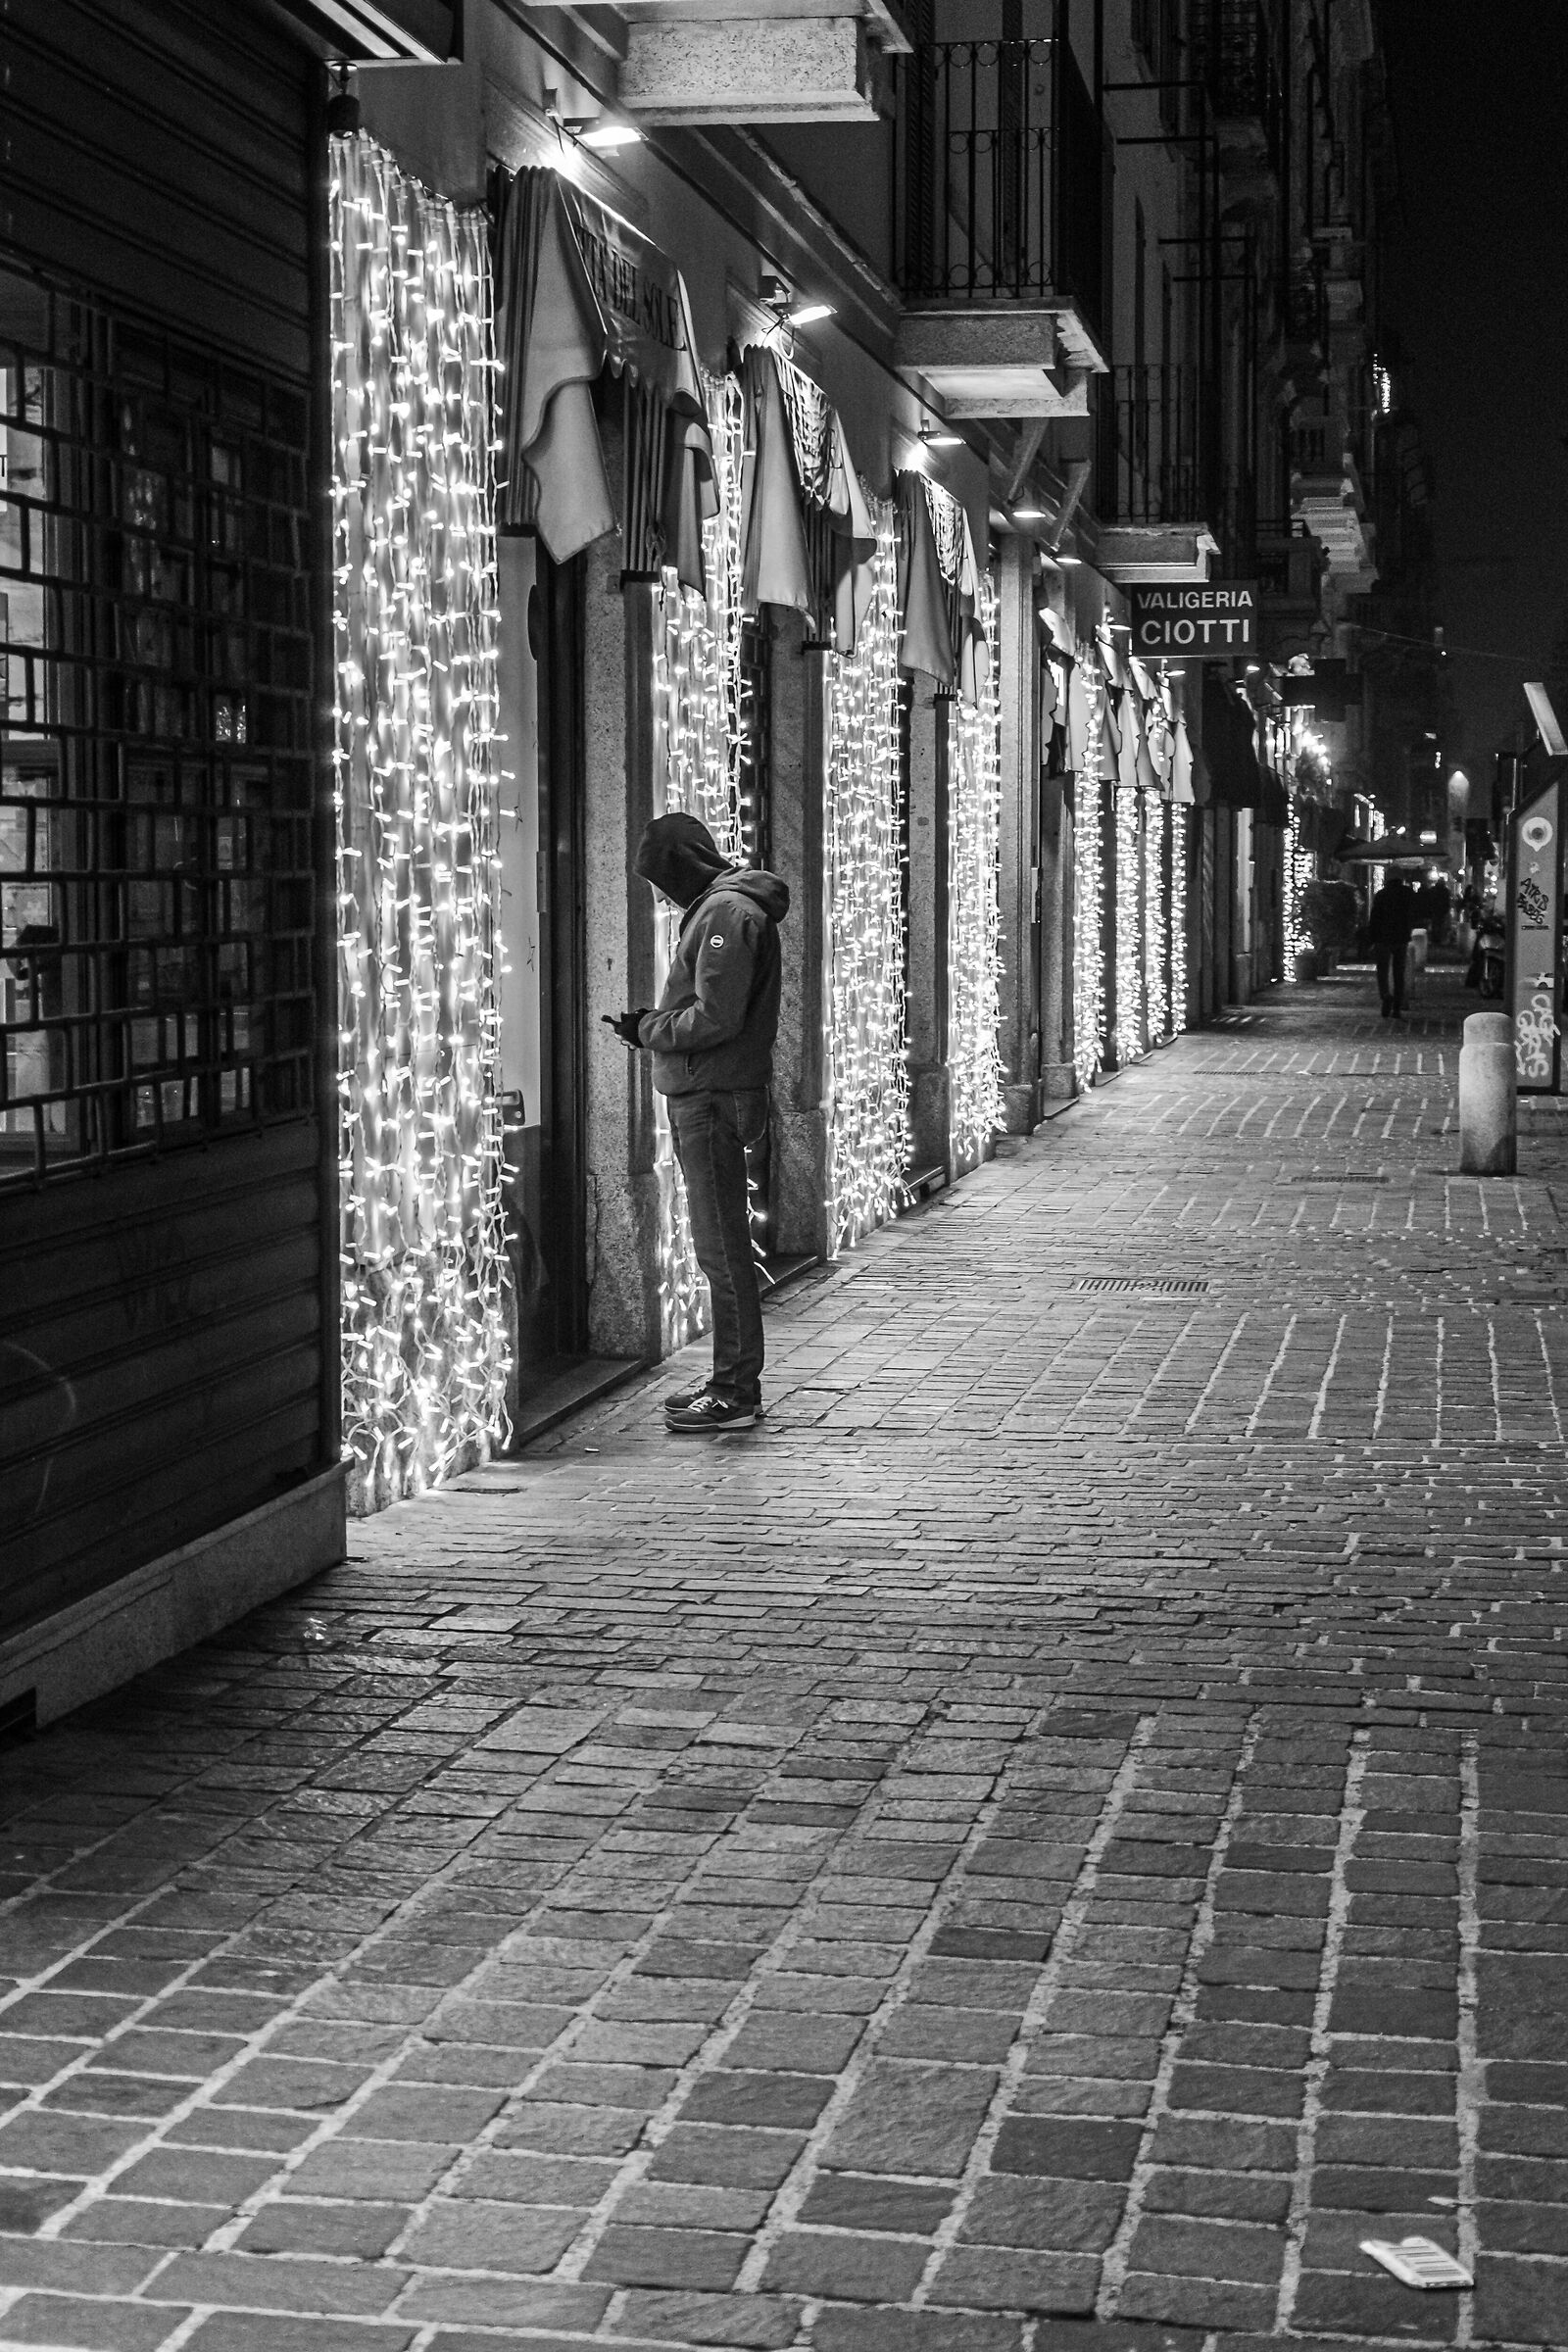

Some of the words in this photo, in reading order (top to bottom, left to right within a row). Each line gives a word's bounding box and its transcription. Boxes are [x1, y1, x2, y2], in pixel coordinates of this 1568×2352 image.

[611, 249, 640, 325] DEL
[1137, 590, 1253, 610] VALIGERIA
[1141, 618, 1250, 645] CIOTTI
